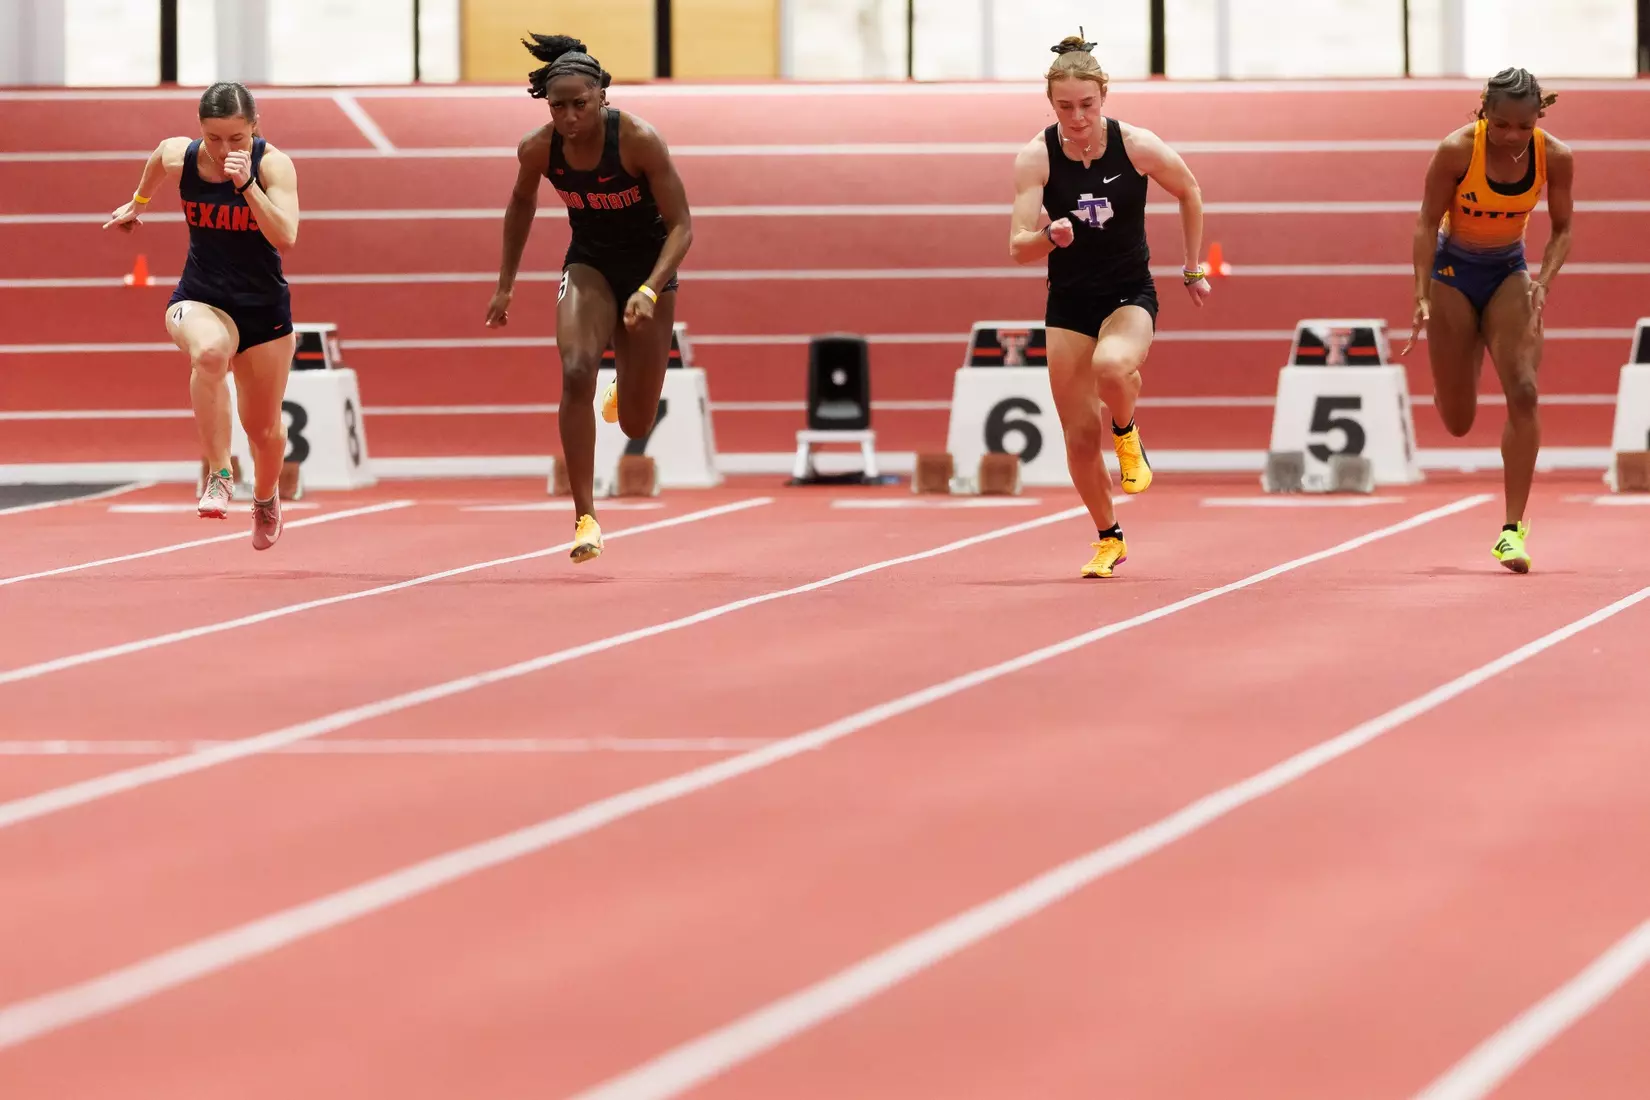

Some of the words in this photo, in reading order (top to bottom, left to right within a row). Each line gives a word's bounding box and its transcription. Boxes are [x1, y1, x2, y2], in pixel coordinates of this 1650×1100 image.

[555, 189, 584, 209] HIO
[587, 185, 641, 209] STATE
[1077, 197, 1108, 227] T
[985, 397, 1043, 465] 6
[1307, 395, 1366, 464] 5
